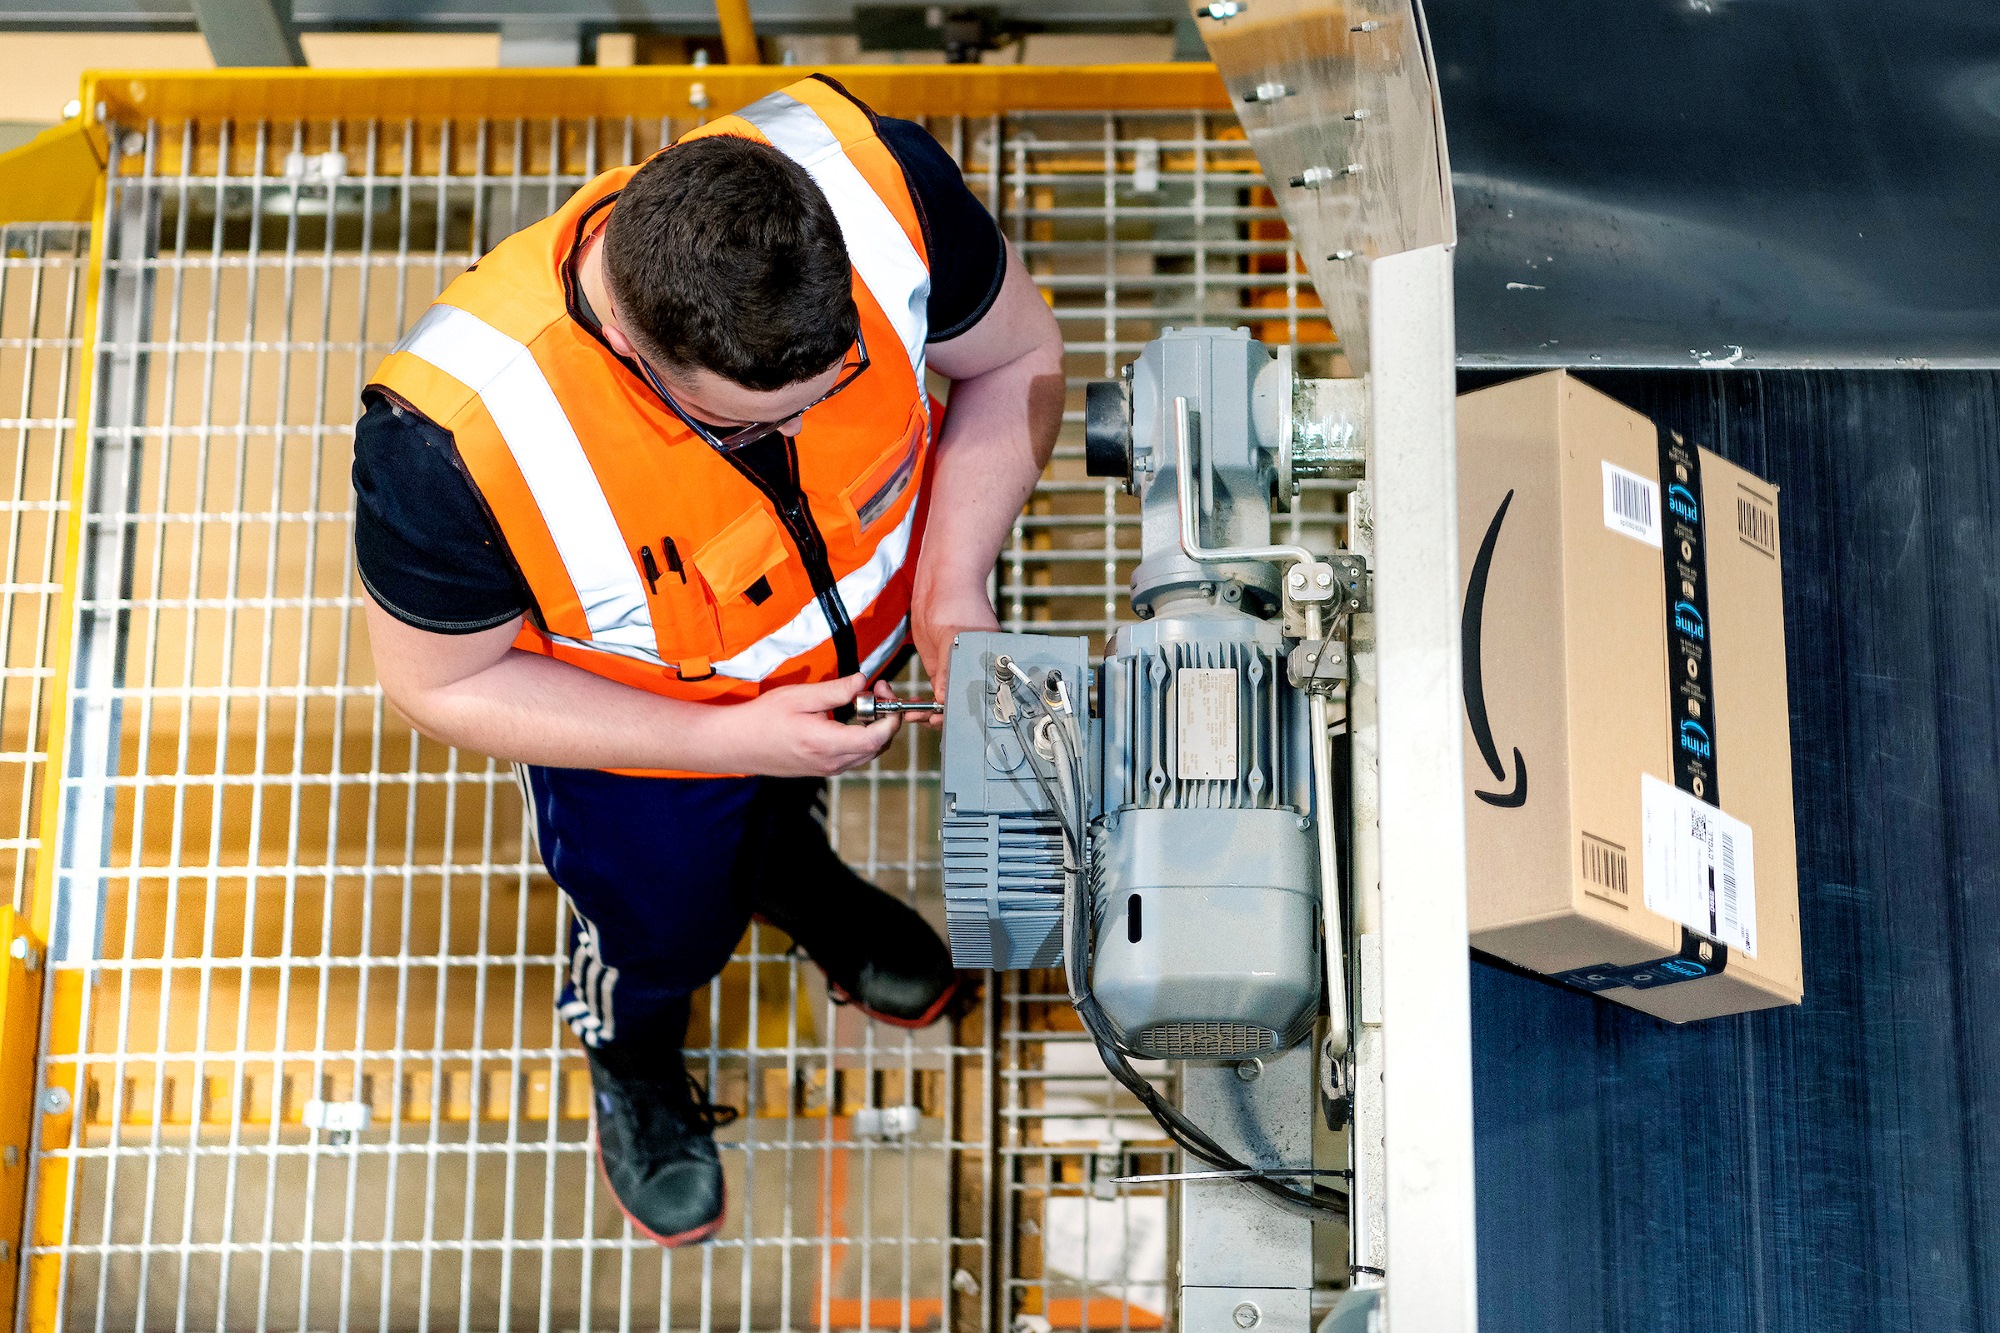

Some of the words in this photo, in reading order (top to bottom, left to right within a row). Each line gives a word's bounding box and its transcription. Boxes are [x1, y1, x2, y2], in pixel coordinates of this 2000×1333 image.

[1669, 497, 1697, 523] prime
[1675, 615, 1704, 640] prime
[1681, 734, 1710, 759] prime
[1660, 961, 1701, 977] prime
